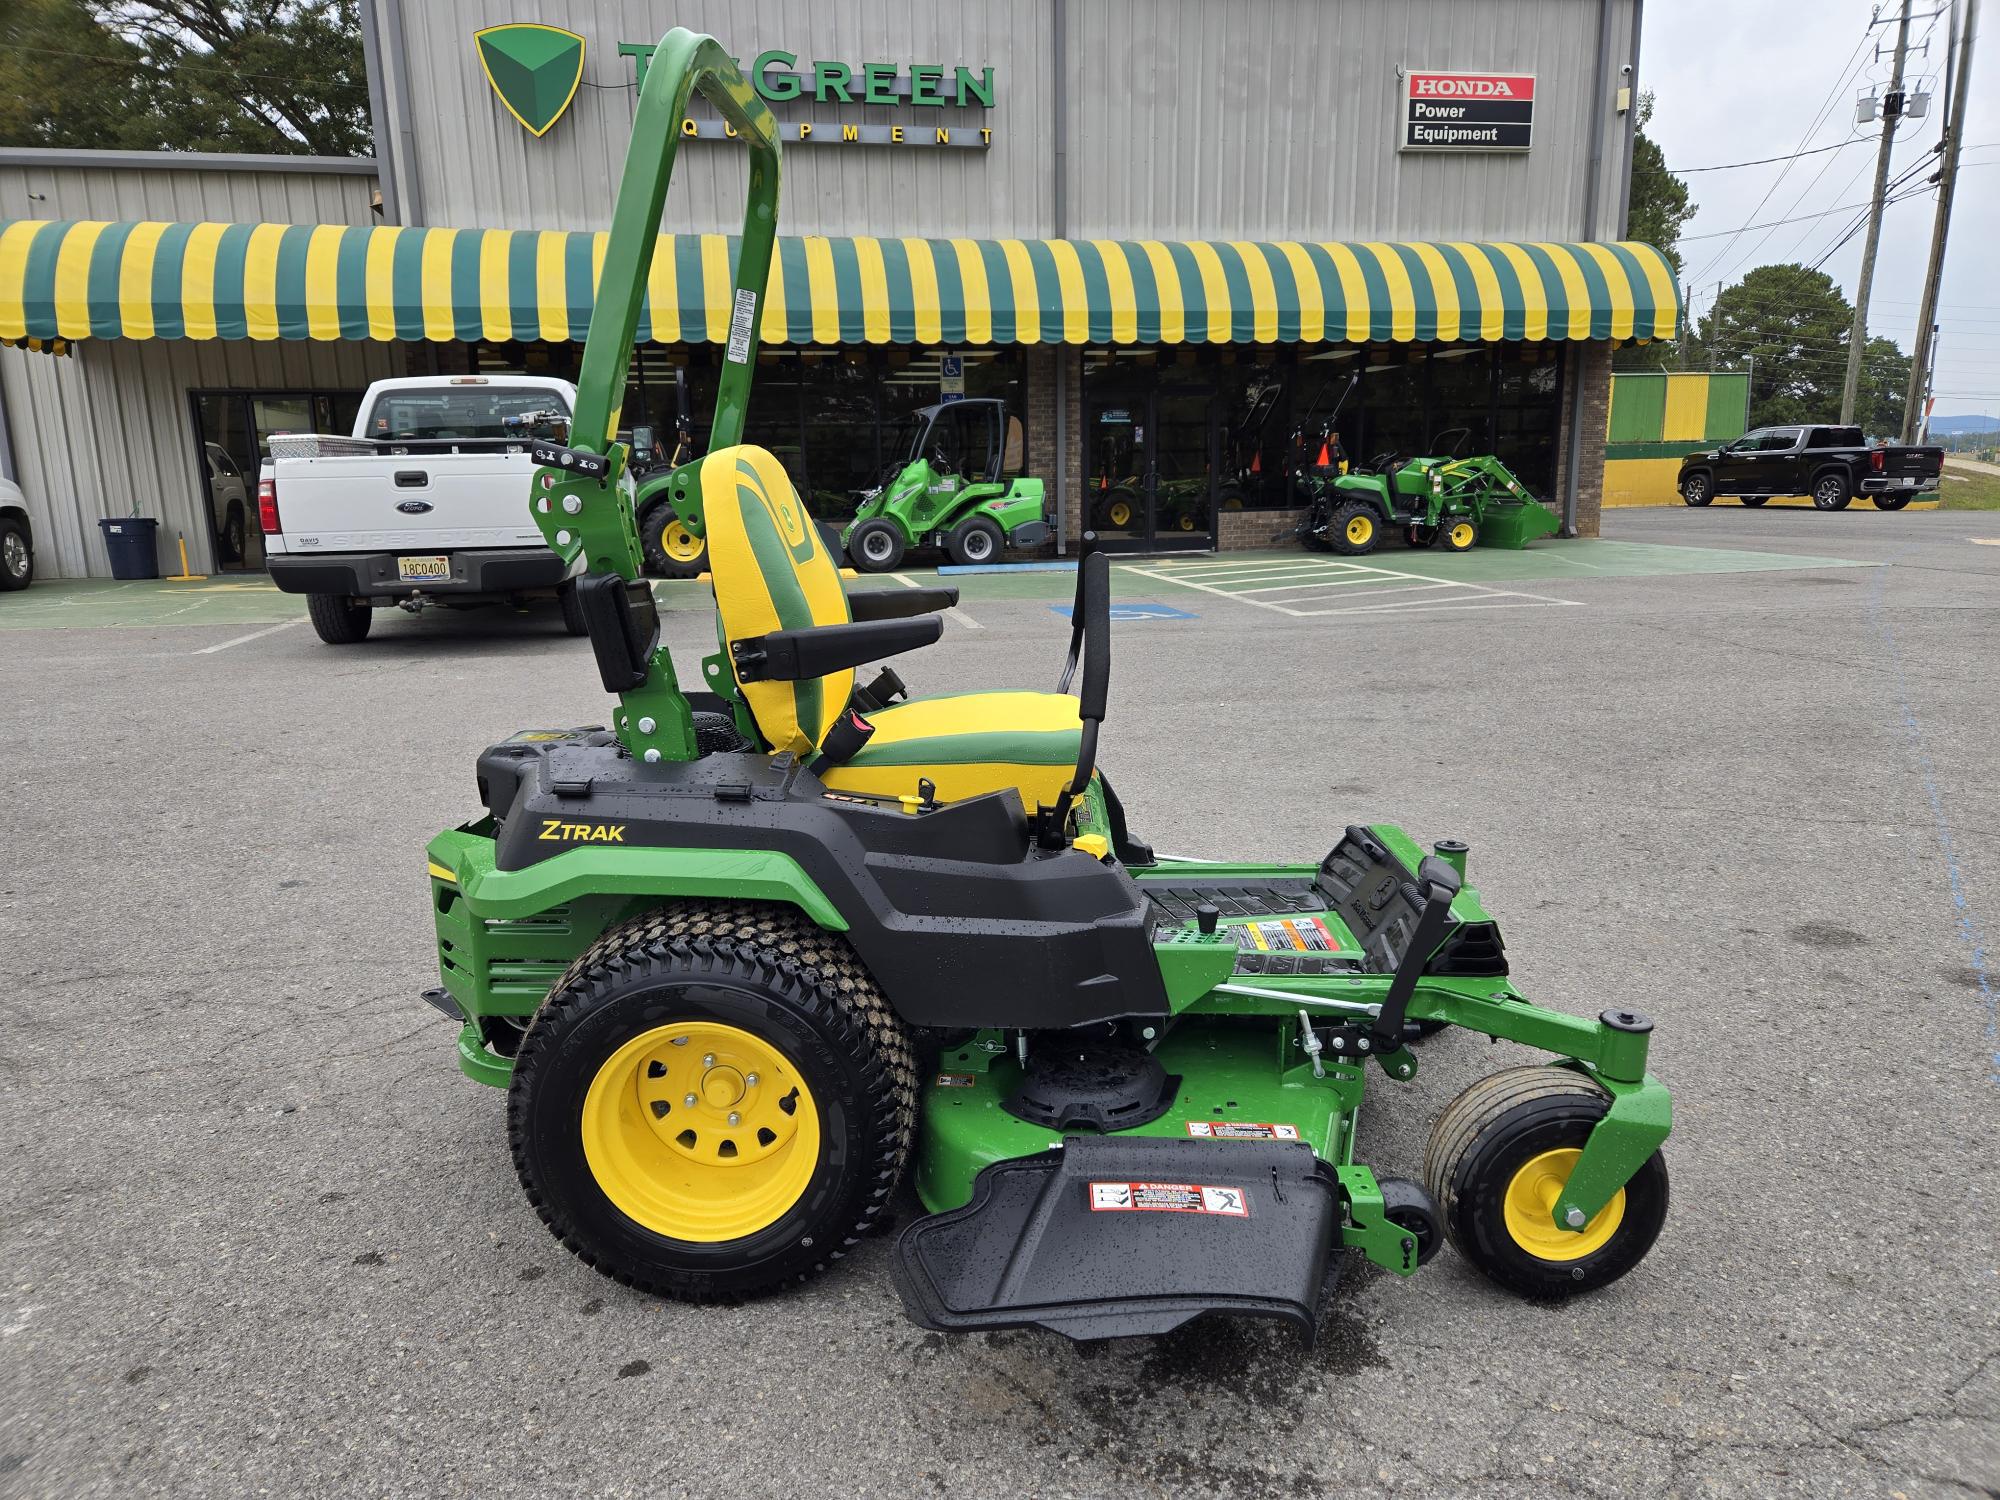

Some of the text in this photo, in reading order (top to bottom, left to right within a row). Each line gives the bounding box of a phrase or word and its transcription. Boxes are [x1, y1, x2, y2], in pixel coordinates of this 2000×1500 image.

[617, 41, 995, 108] TGREEN
[1416, 80, 1513, 96] HONDA
[1415, 103, 1466, 118] Power
[681, 117, 992, 145] QUPMENT
[1414, 126, 1498, 142] Equipment
[538, 820, 626, 841] ZTRAK
[1149, 1183, 1193, 1191] DANGER
